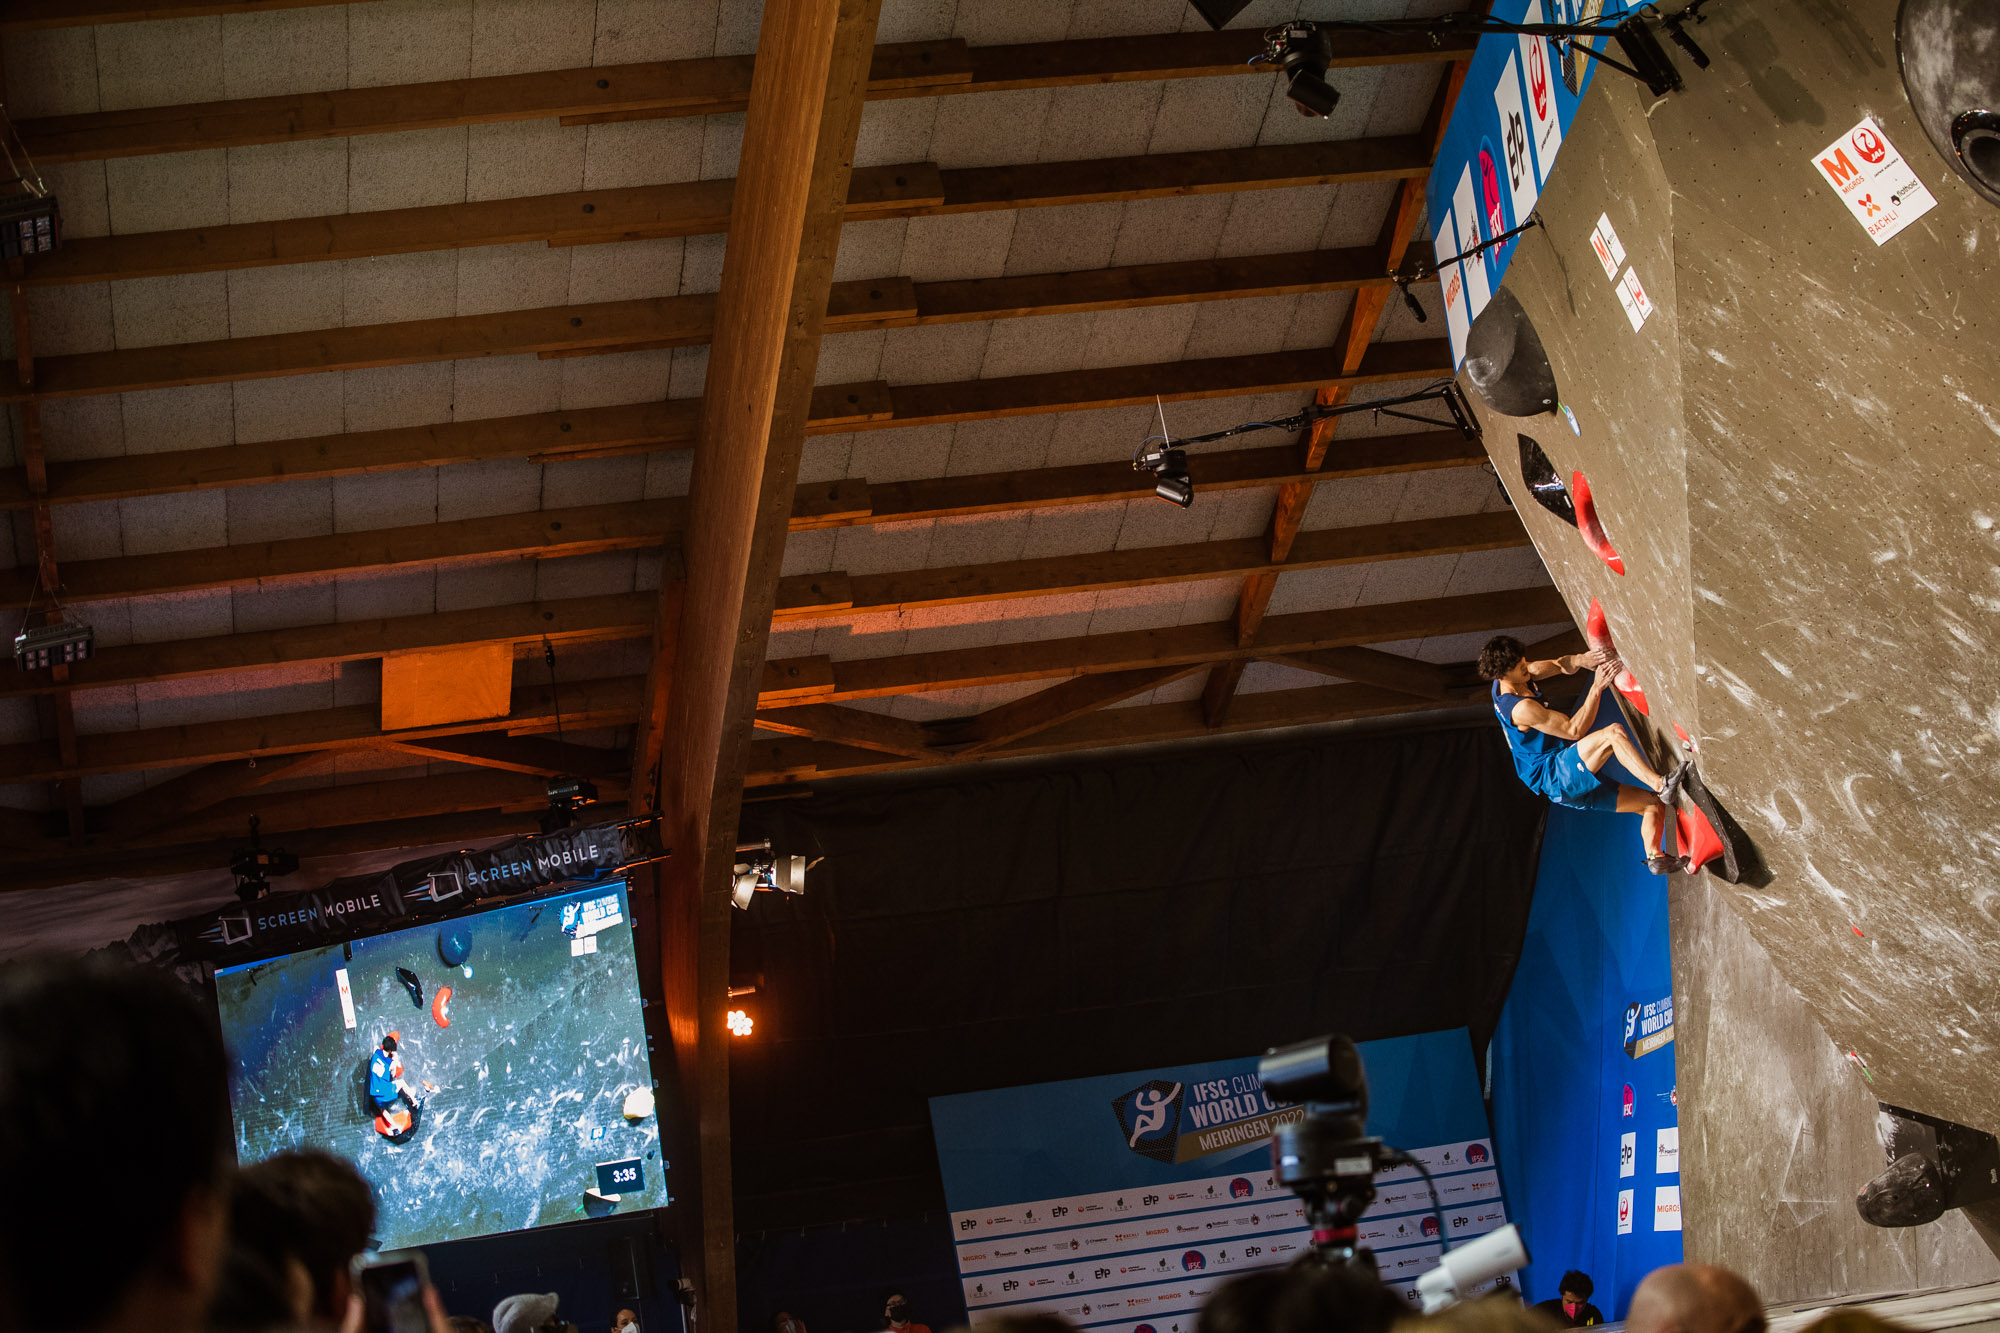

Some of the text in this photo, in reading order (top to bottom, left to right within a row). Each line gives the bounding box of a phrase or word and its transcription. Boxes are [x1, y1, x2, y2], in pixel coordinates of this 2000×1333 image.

[1871, 148, 1885, 163] JAL
[1842, 175, 1865, 195] MIGROS
[467, 844, 599, 886] SCREEN MOBILE
[257, 893, 381, 931] SCREEN MOBILE
[1644, 1002, 1656, 1018] IFSC
[1641, 1013, 1664, 1036] WORLD
[1192, 1079, 1230, 1103] IFSC
[1189, 1093, 1258, 1129] WORLD
[1199, 1118, 1271, 1151] MEIRINGEN
[613, 1167, 637, 1183] 3:35
[1657, 1204, 1680, 1213] MIGROS
